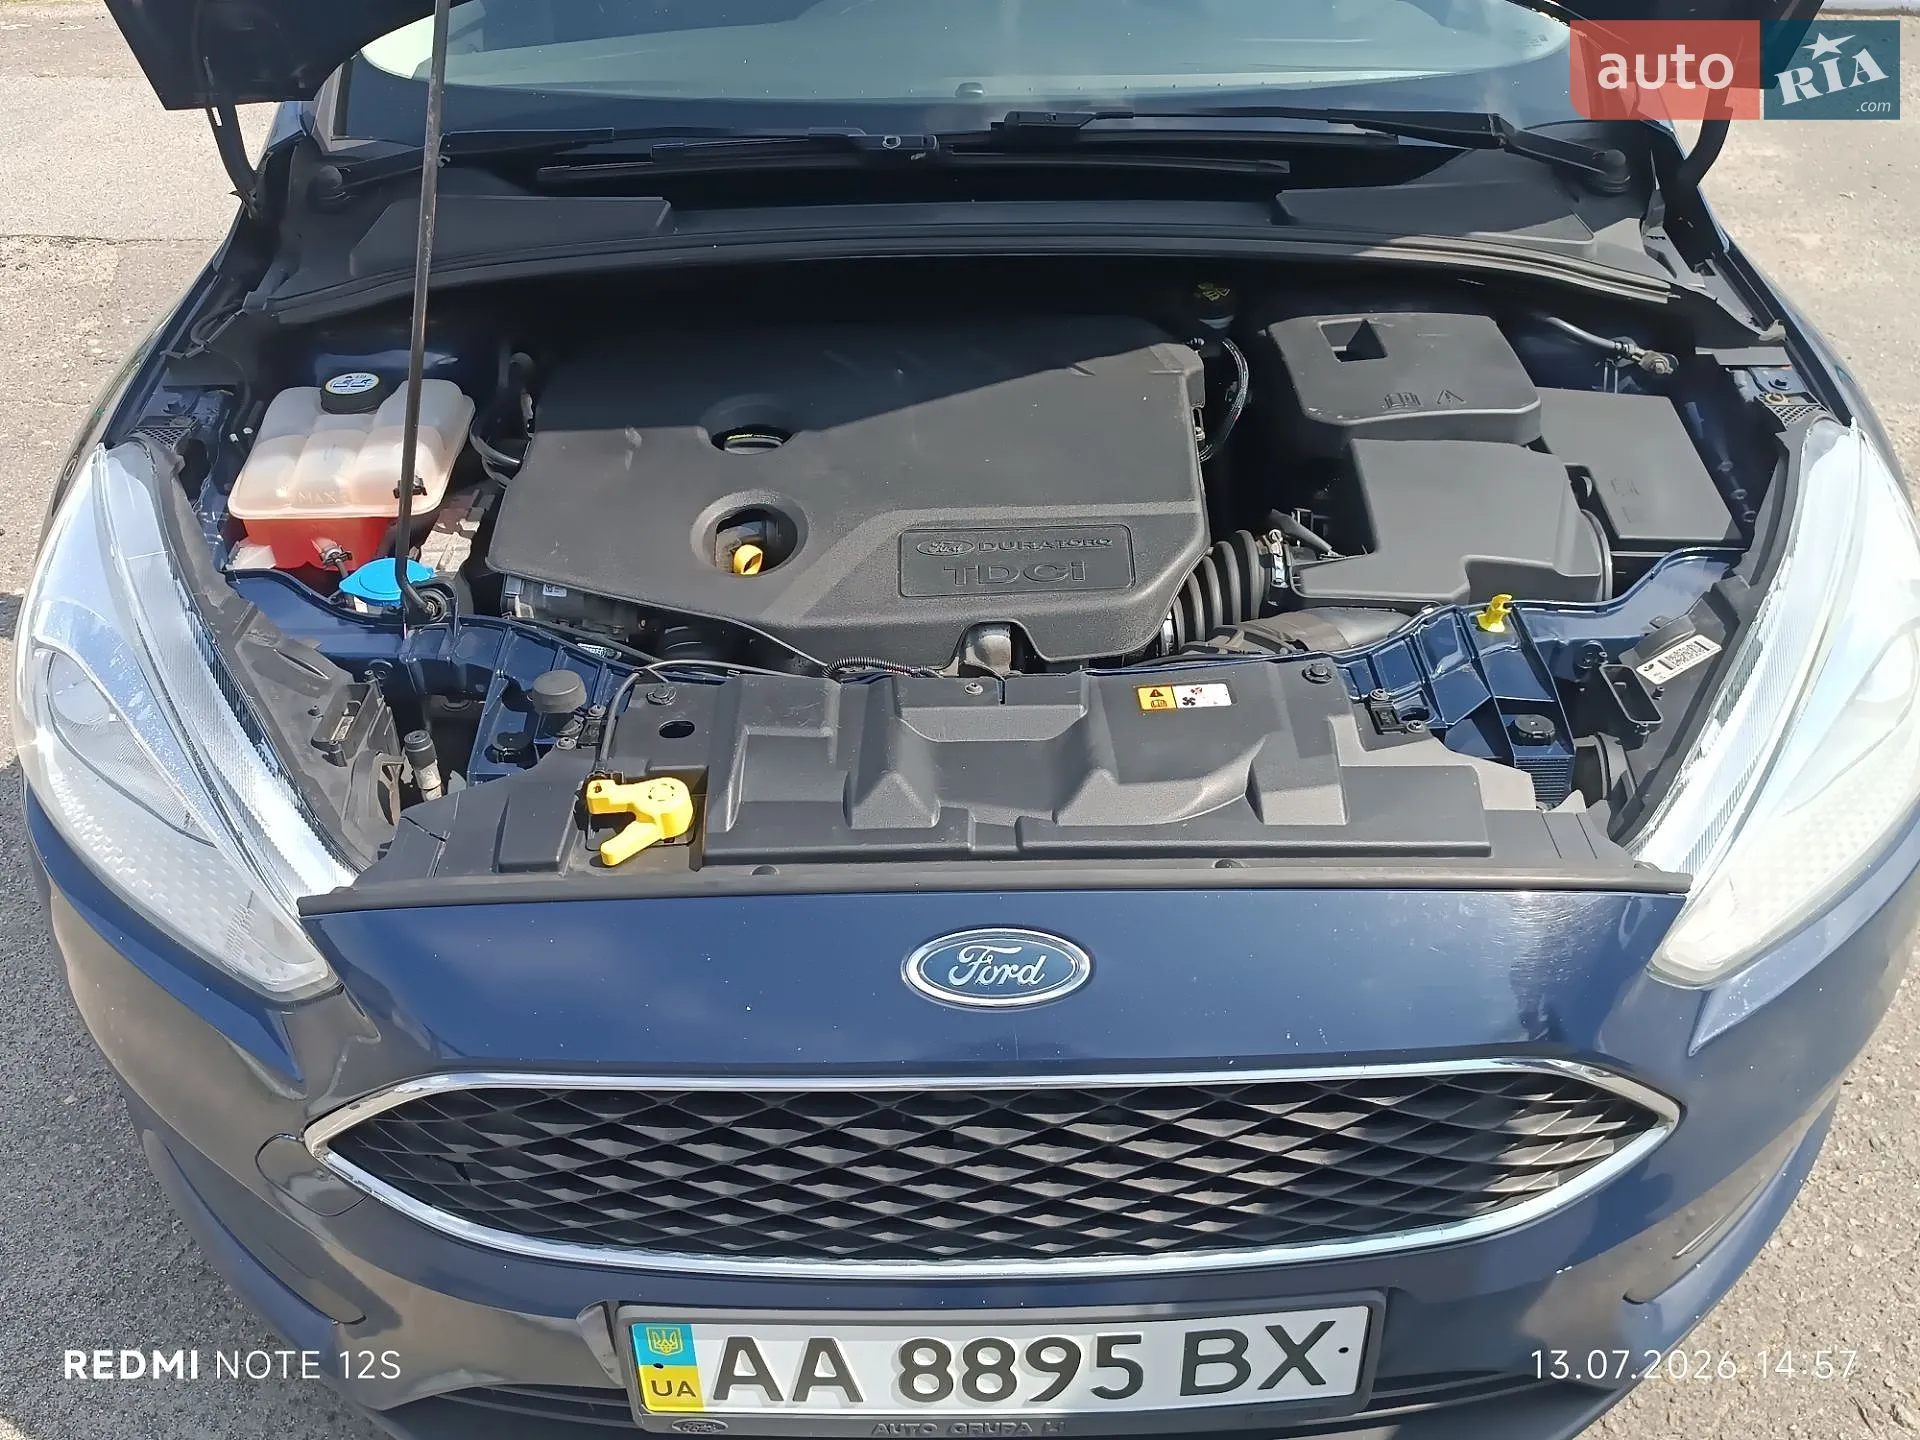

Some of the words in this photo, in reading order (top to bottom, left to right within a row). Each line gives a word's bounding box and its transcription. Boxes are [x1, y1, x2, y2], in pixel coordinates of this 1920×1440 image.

[948, 945, 1047, 986] Ford
[713, 1335, 864, 1402] AA
[896, 1332, 1144, 1402] 8895
[1179, 1320, 1337, 1397] BX
[651, 1380, 697, 1398] UA
[872, 1422, 938, 1436] AUTO
[948, 1421, 1033, 1436] GRUPA
